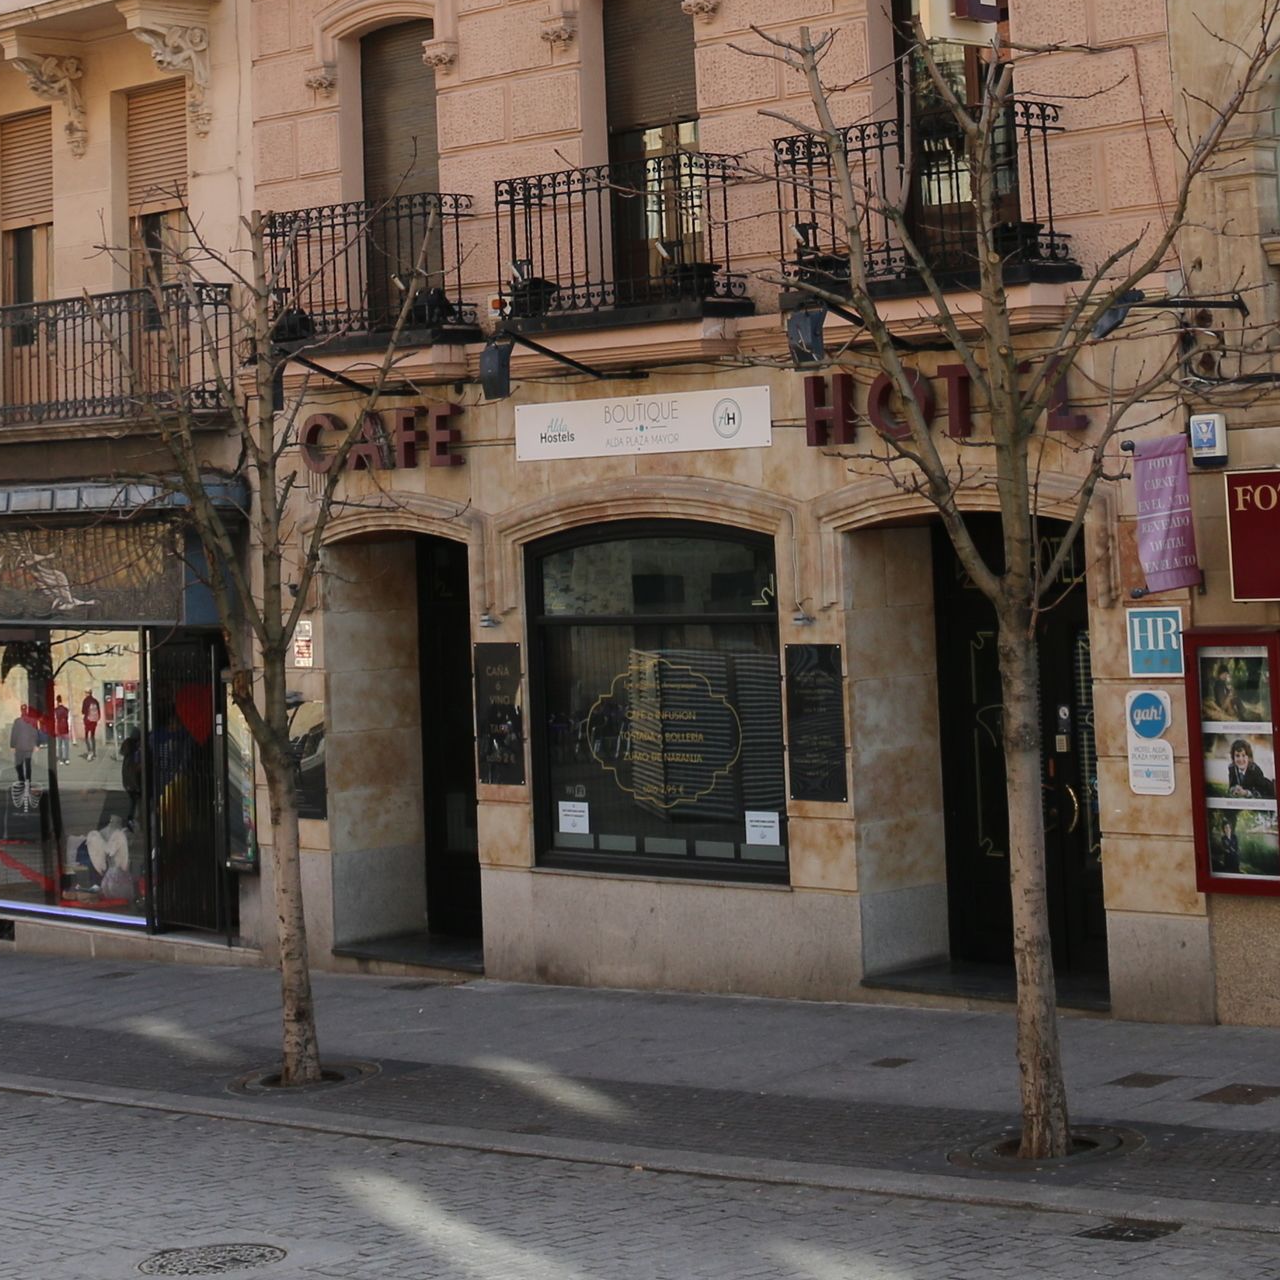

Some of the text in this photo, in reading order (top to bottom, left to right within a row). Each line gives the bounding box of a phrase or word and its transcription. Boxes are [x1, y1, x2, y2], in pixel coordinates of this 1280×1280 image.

[804, 356, 1089, 447] HOTL
[603, 401, 679, 424] BOUTIQUE
[546, 418, 568, 434] Alda
[540, 431, 575, 444] Hostels
[605, 433, 680, 448] ALDA PLAZA MAYOR
[1148, 456, 1173, 470] FOTO
[1138, 499, 1151, 513] EN
[1153, 498, 1166, 511] EL
[1131, 616, 1180, 651] HR
[486, 665, 510, 677] CAÑA
[489, 695, 510, 706] VINO
[1133, 707, 1163, 726] gah!
[1131, 752, 1169, 761] PLAZA MAYOR
[1134, 745, 1166, 754] HOTEL ALDA
